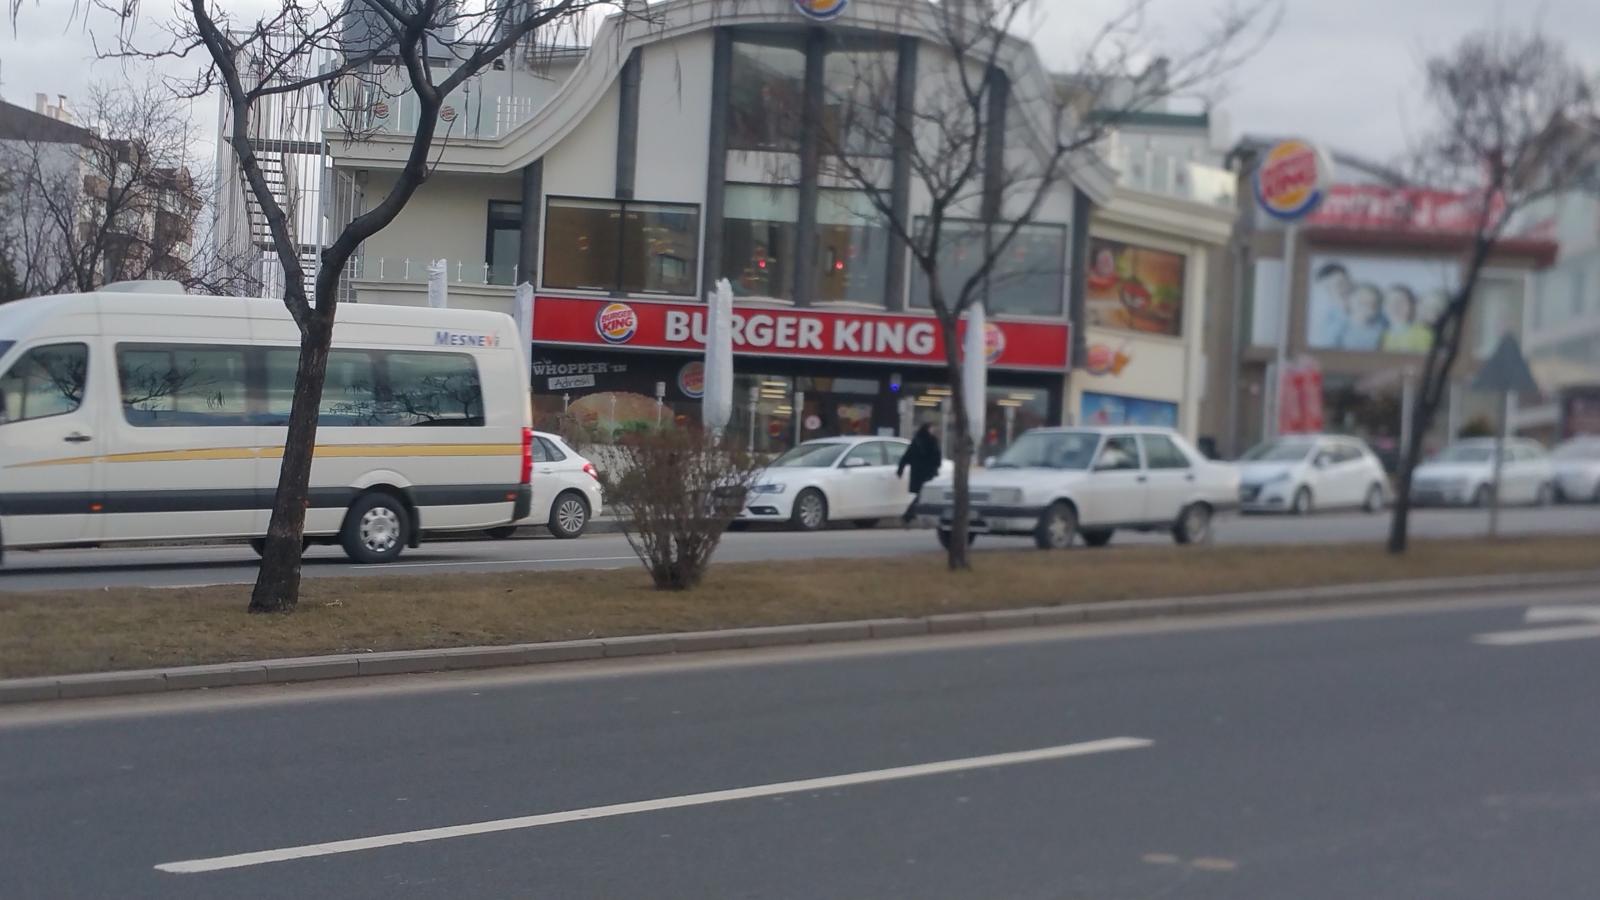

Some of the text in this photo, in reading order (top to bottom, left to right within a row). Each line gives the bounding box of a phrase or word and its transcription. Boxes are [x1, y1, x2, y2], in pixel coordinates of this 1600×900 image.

[601, 309, 632, 323] BURGER
[602, 316, 633, 333] KING
[665, 310, 935, 355] BURGER KING
[532, 362, 608, 375] WHOPPER
